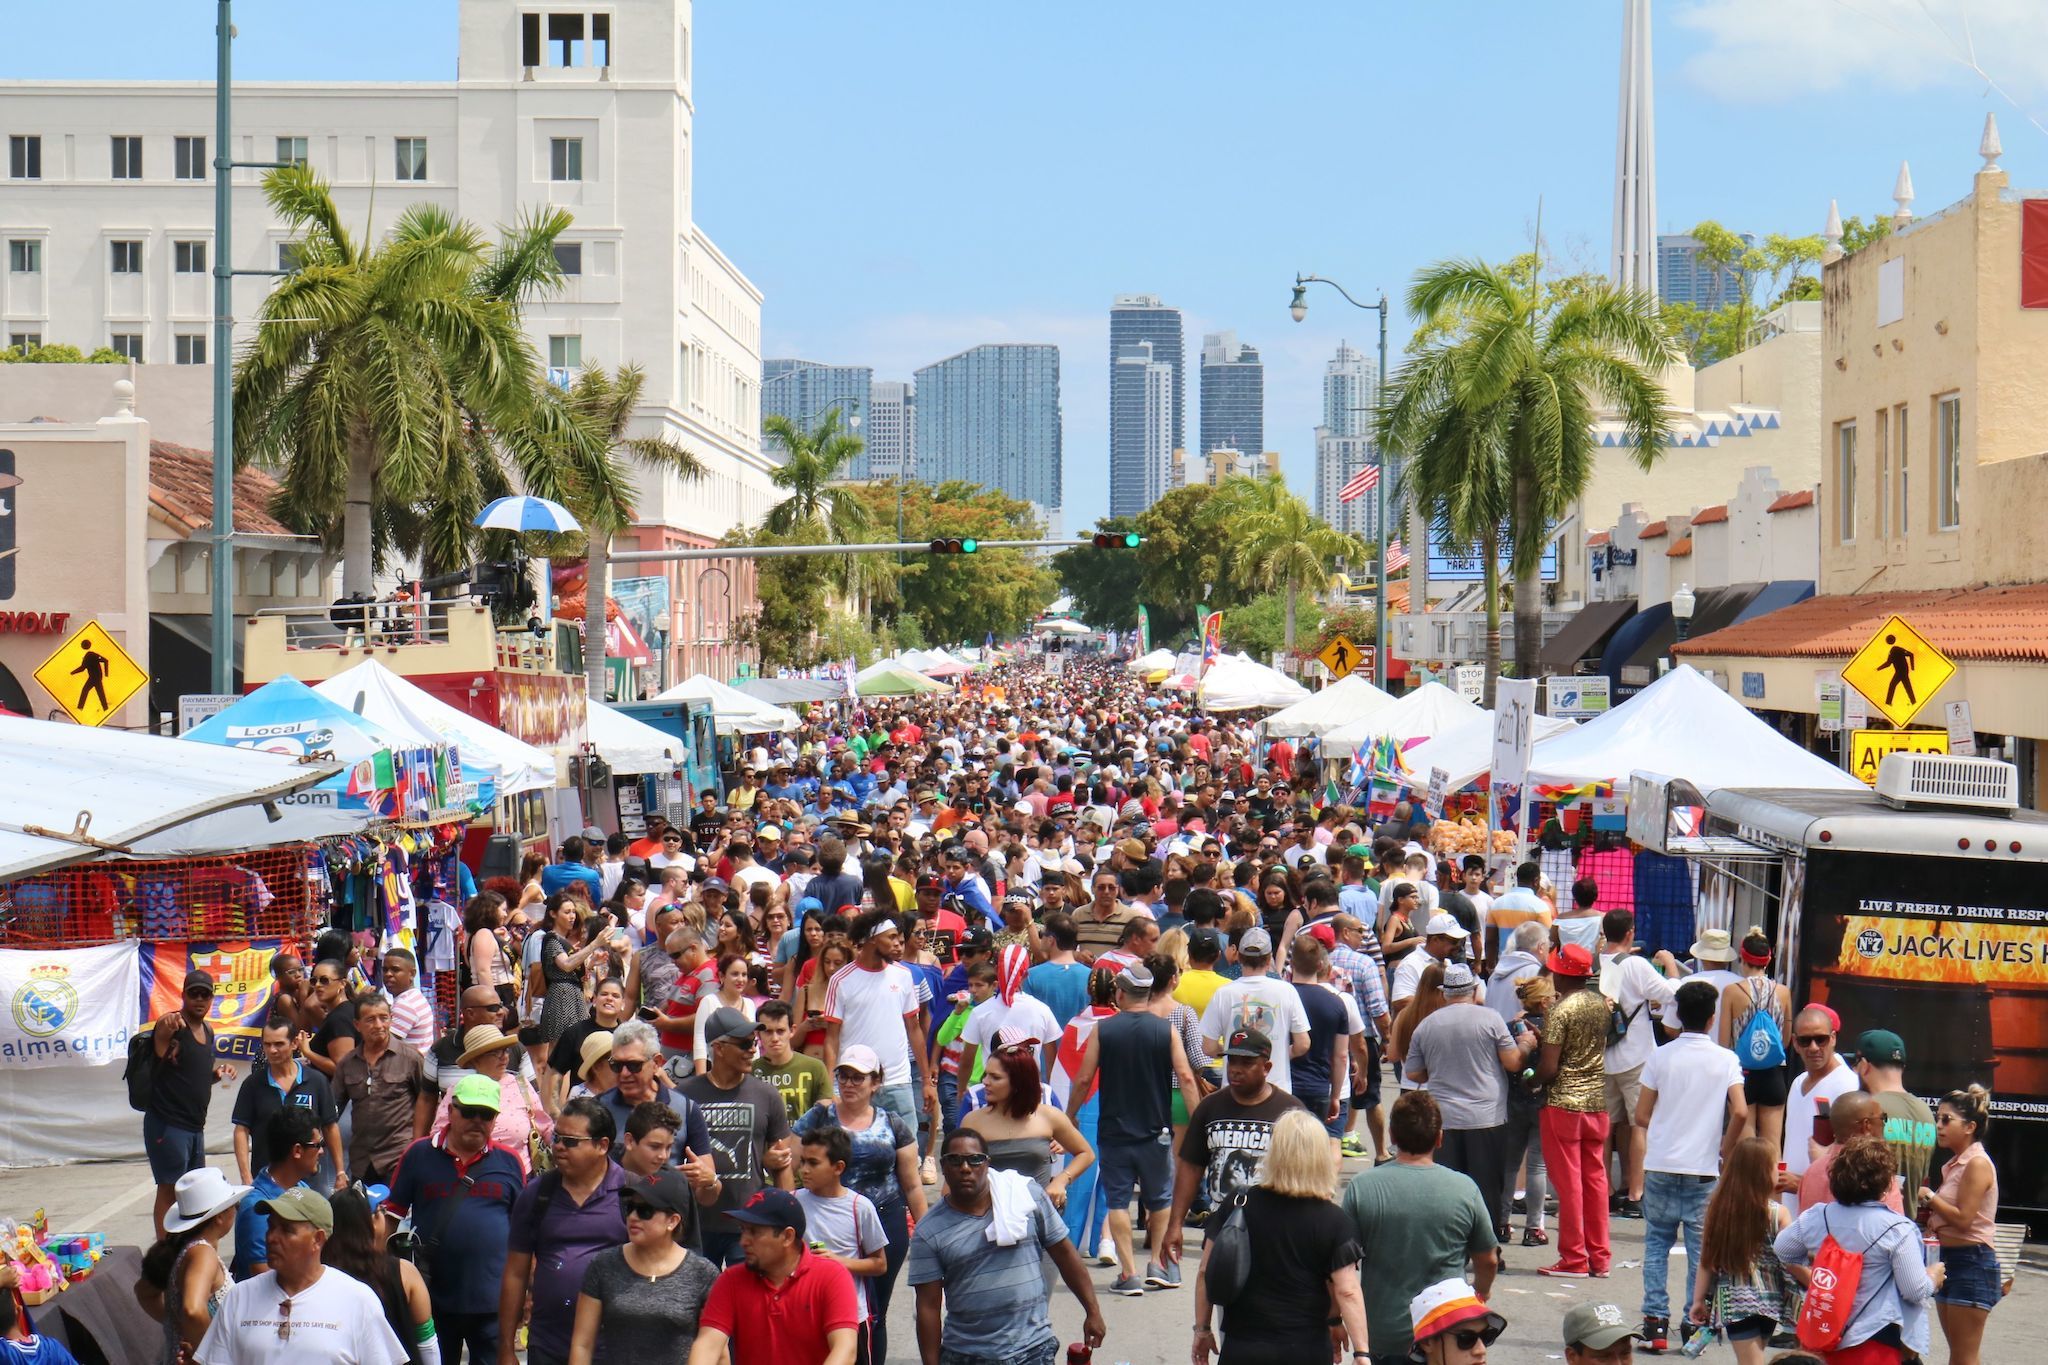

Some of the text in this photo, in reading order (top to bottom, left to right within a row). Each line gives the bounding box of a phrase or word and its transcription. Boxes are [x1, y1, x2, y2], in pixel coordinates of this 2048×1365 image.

[1447, 561, 1475, 570] MARCH
[1464, 687, 1480, 695] RED
[244, 723, 302, 736] Local
[305, 732, 334, 744] abc
[1859, 900, 1893, 912] LIVE
[1896, 902, 1953, 916] FREELY.
[1957, 906, 2004, 919] DRINK
[1888, 935, 1954, 958] JACK
[1964, 939, 2033, 964] LIVES
